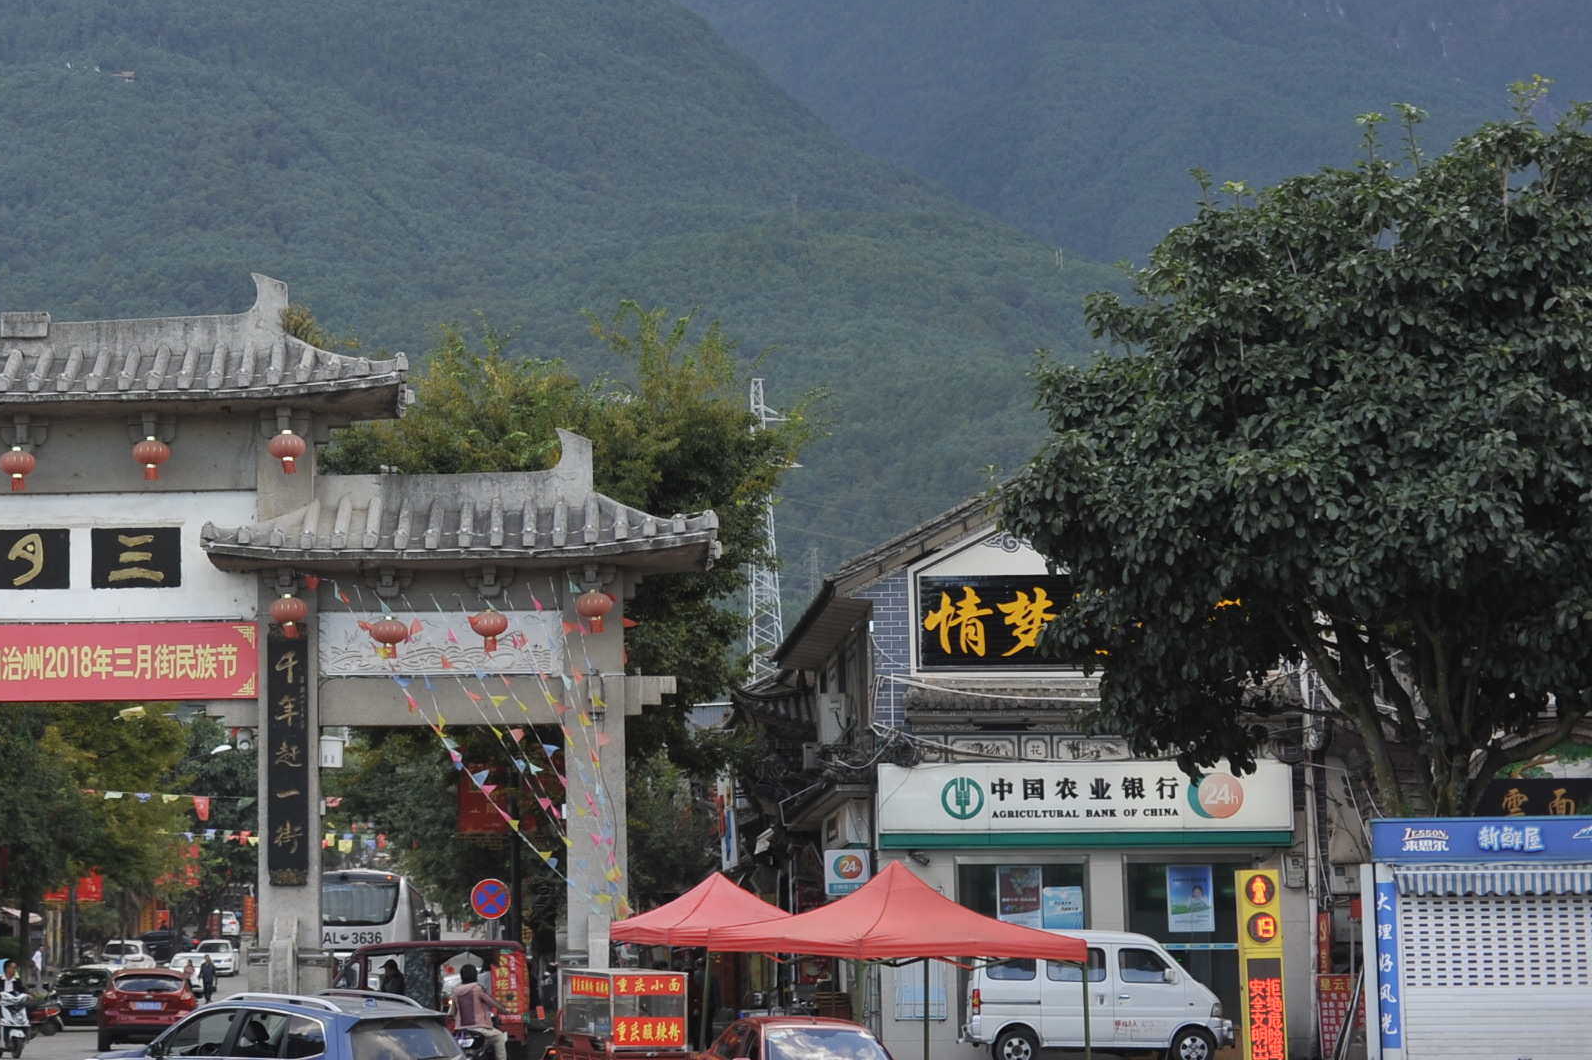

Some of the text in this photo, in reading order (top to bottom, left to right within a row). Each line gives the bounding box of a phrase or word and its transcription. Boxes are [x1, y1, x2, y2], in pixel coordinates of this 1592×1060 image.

[991, 777, 1179, 801] 中国农业银行
[1204, 782, 1239, 805] 24h
[992, 808, 1179, 818] AGRICULTURAL BANK OF CHINA
[1479, 826, 1544, 851] 新鲜屋
[841, 860, 861, 873] 24h
[1257, 916, 1276, 938] 19
[1377, 892, 1398, 1034] 大理好风光
[616, 977, 680, 993] 重庆小面
[616, 1021, 680, 1042] 重庆酸辣粉
